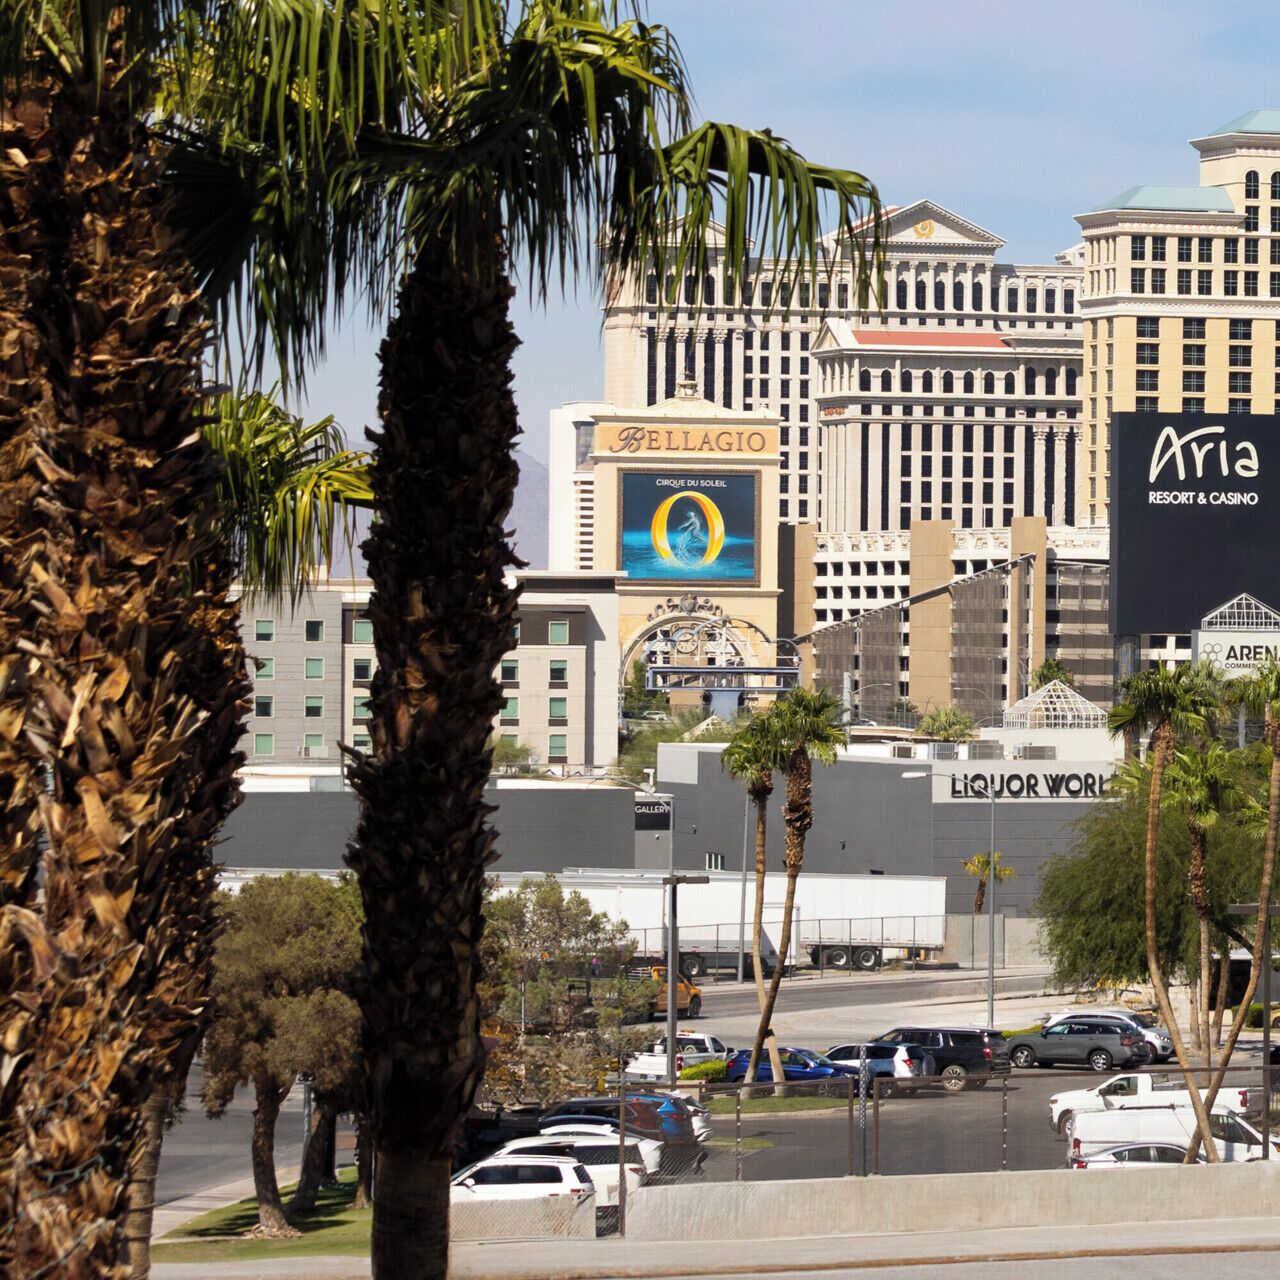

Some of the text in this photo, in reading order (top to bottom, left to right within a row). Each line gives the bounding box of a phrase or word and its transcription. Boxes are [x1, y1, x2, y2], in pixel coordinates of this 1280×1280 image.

[608, 425, 766, 453] BELLAGIO
[1149, 425, 1259, 483] Aria
[656, 478, 686, 488] CIRQUE
[687, 479, 699, 487] DU
[1149, 491, 1259, 506] RESORT & CASINO
[951, 772, 1110, 799] LIQUOR WORL
[635, 805, 670, 813] GALLERY
